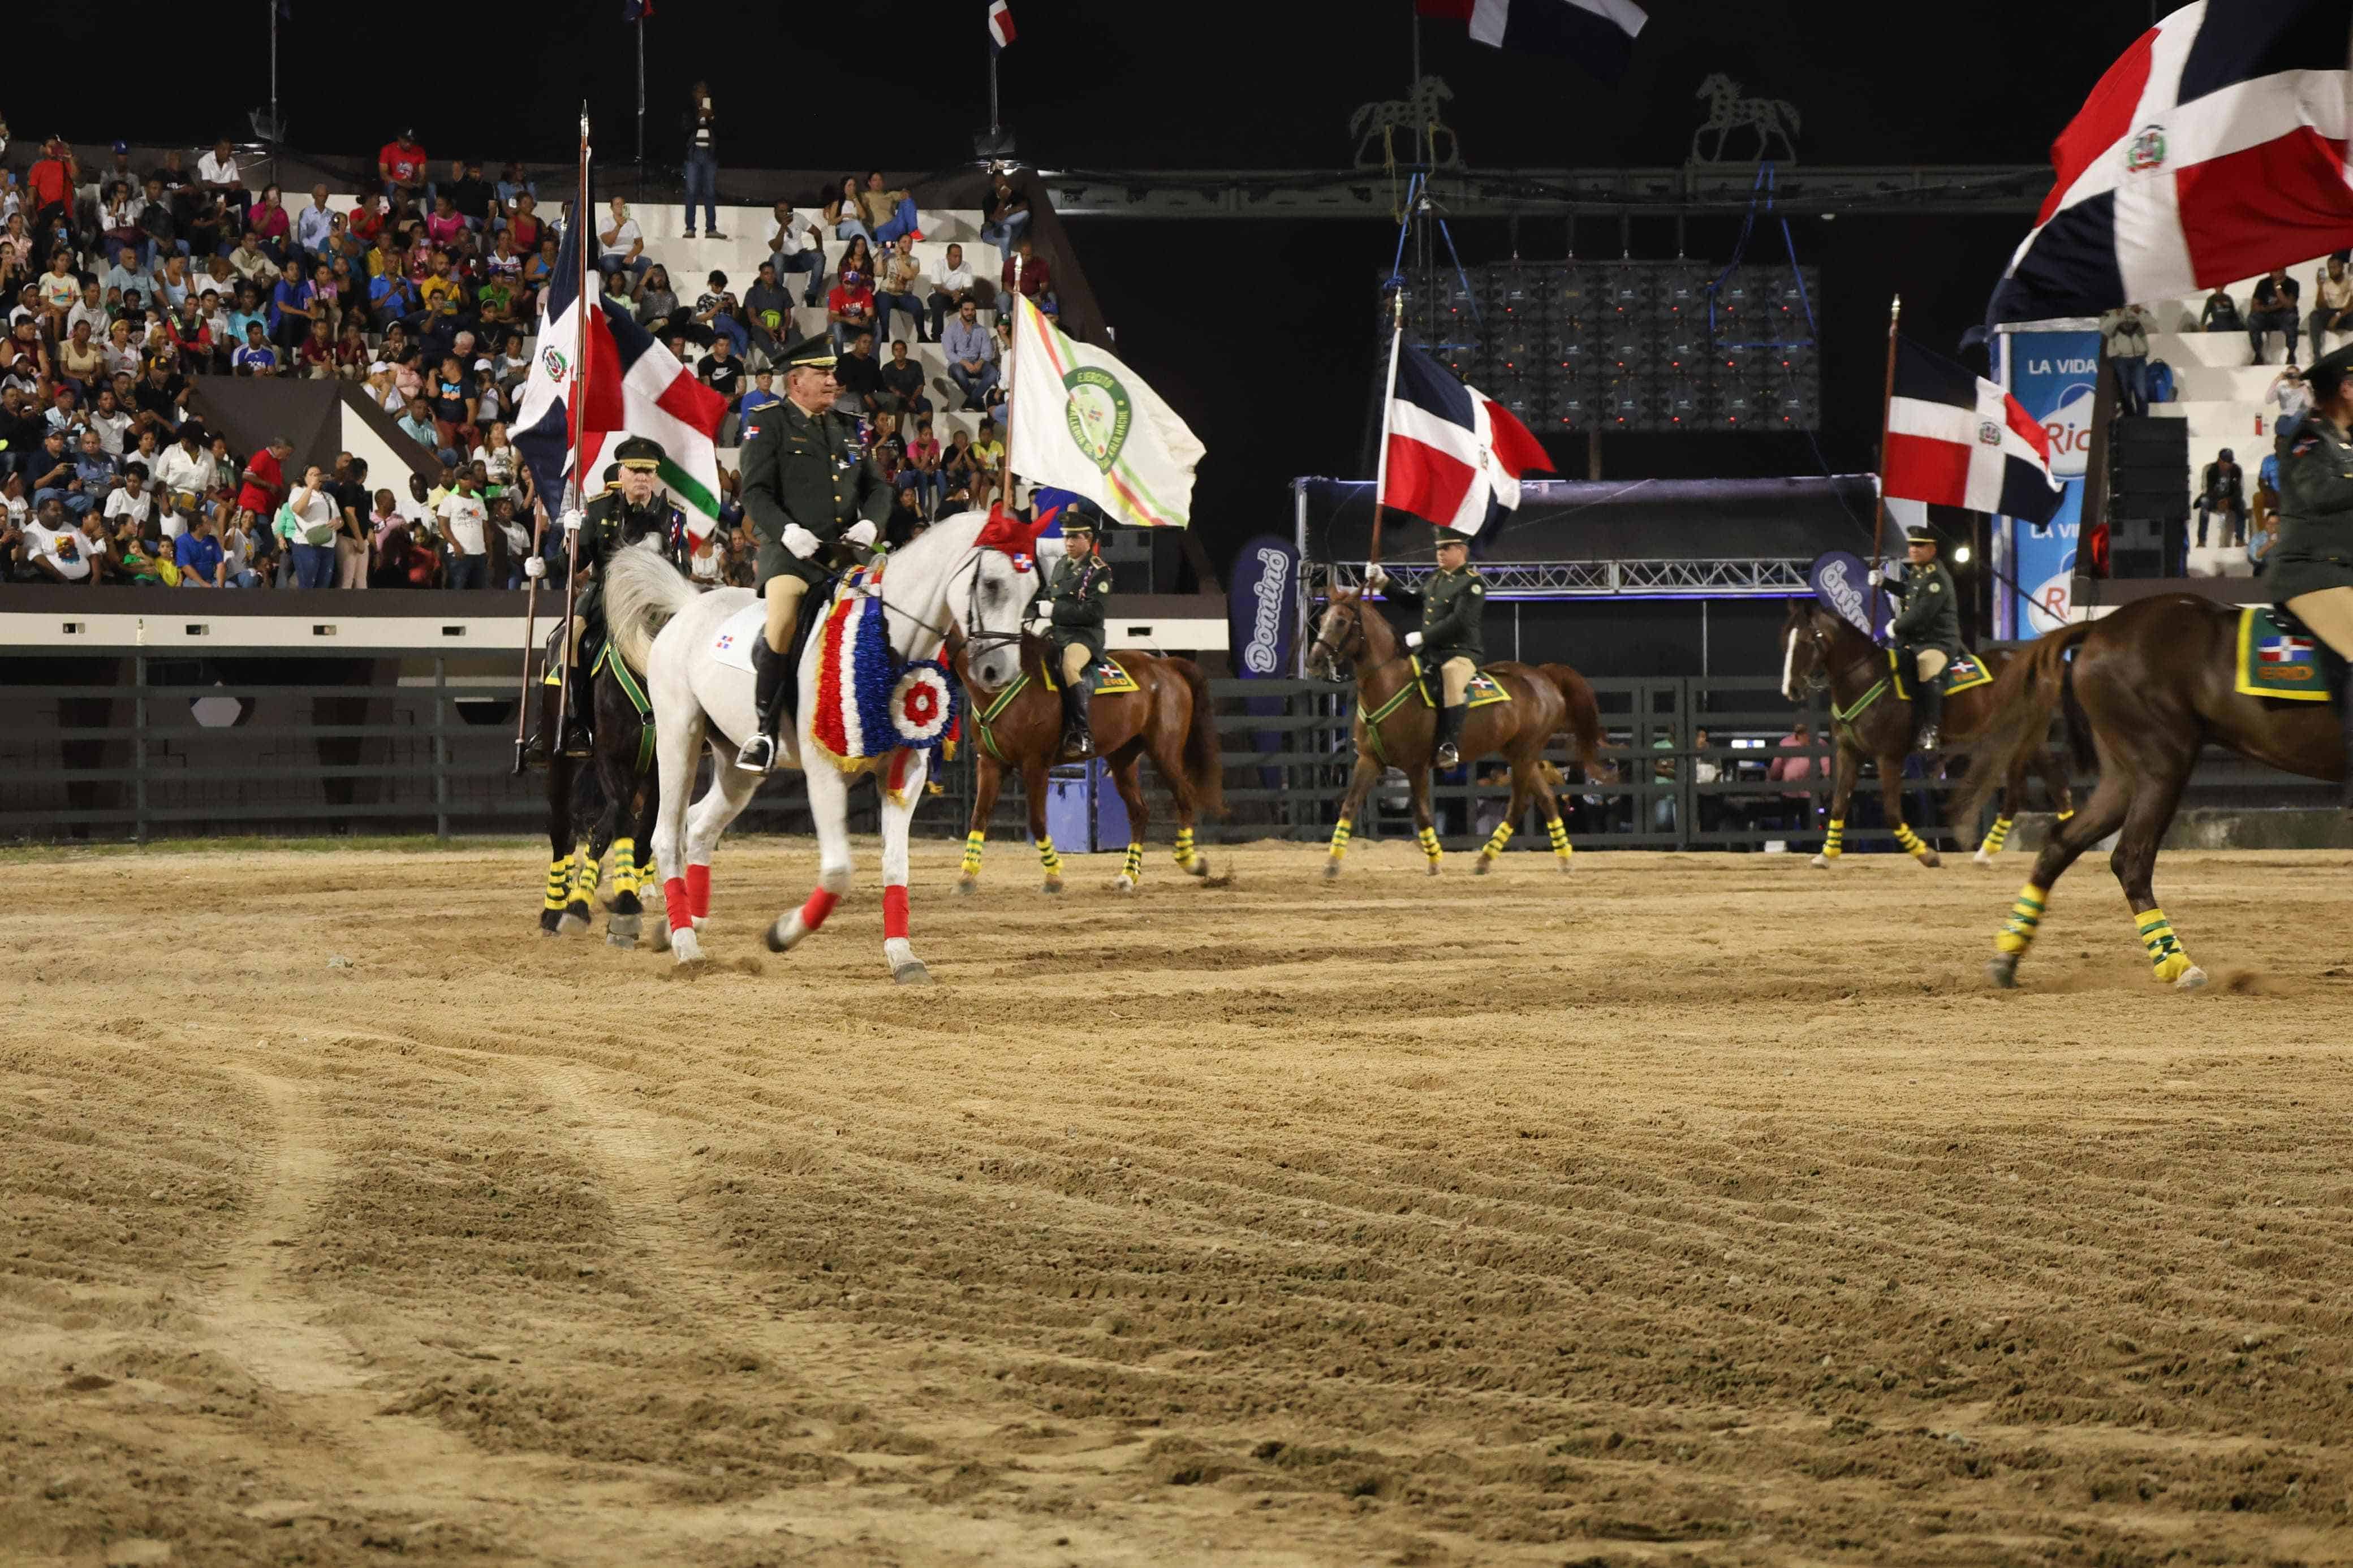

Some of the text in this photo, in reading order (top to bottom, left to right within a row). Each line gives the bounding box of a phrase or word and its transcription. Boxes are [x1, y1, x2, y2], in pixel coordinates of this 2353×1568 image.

[2029, 358, 2098, 374] LA VIDA
[2031, 523, 2081, 539] LA VI
